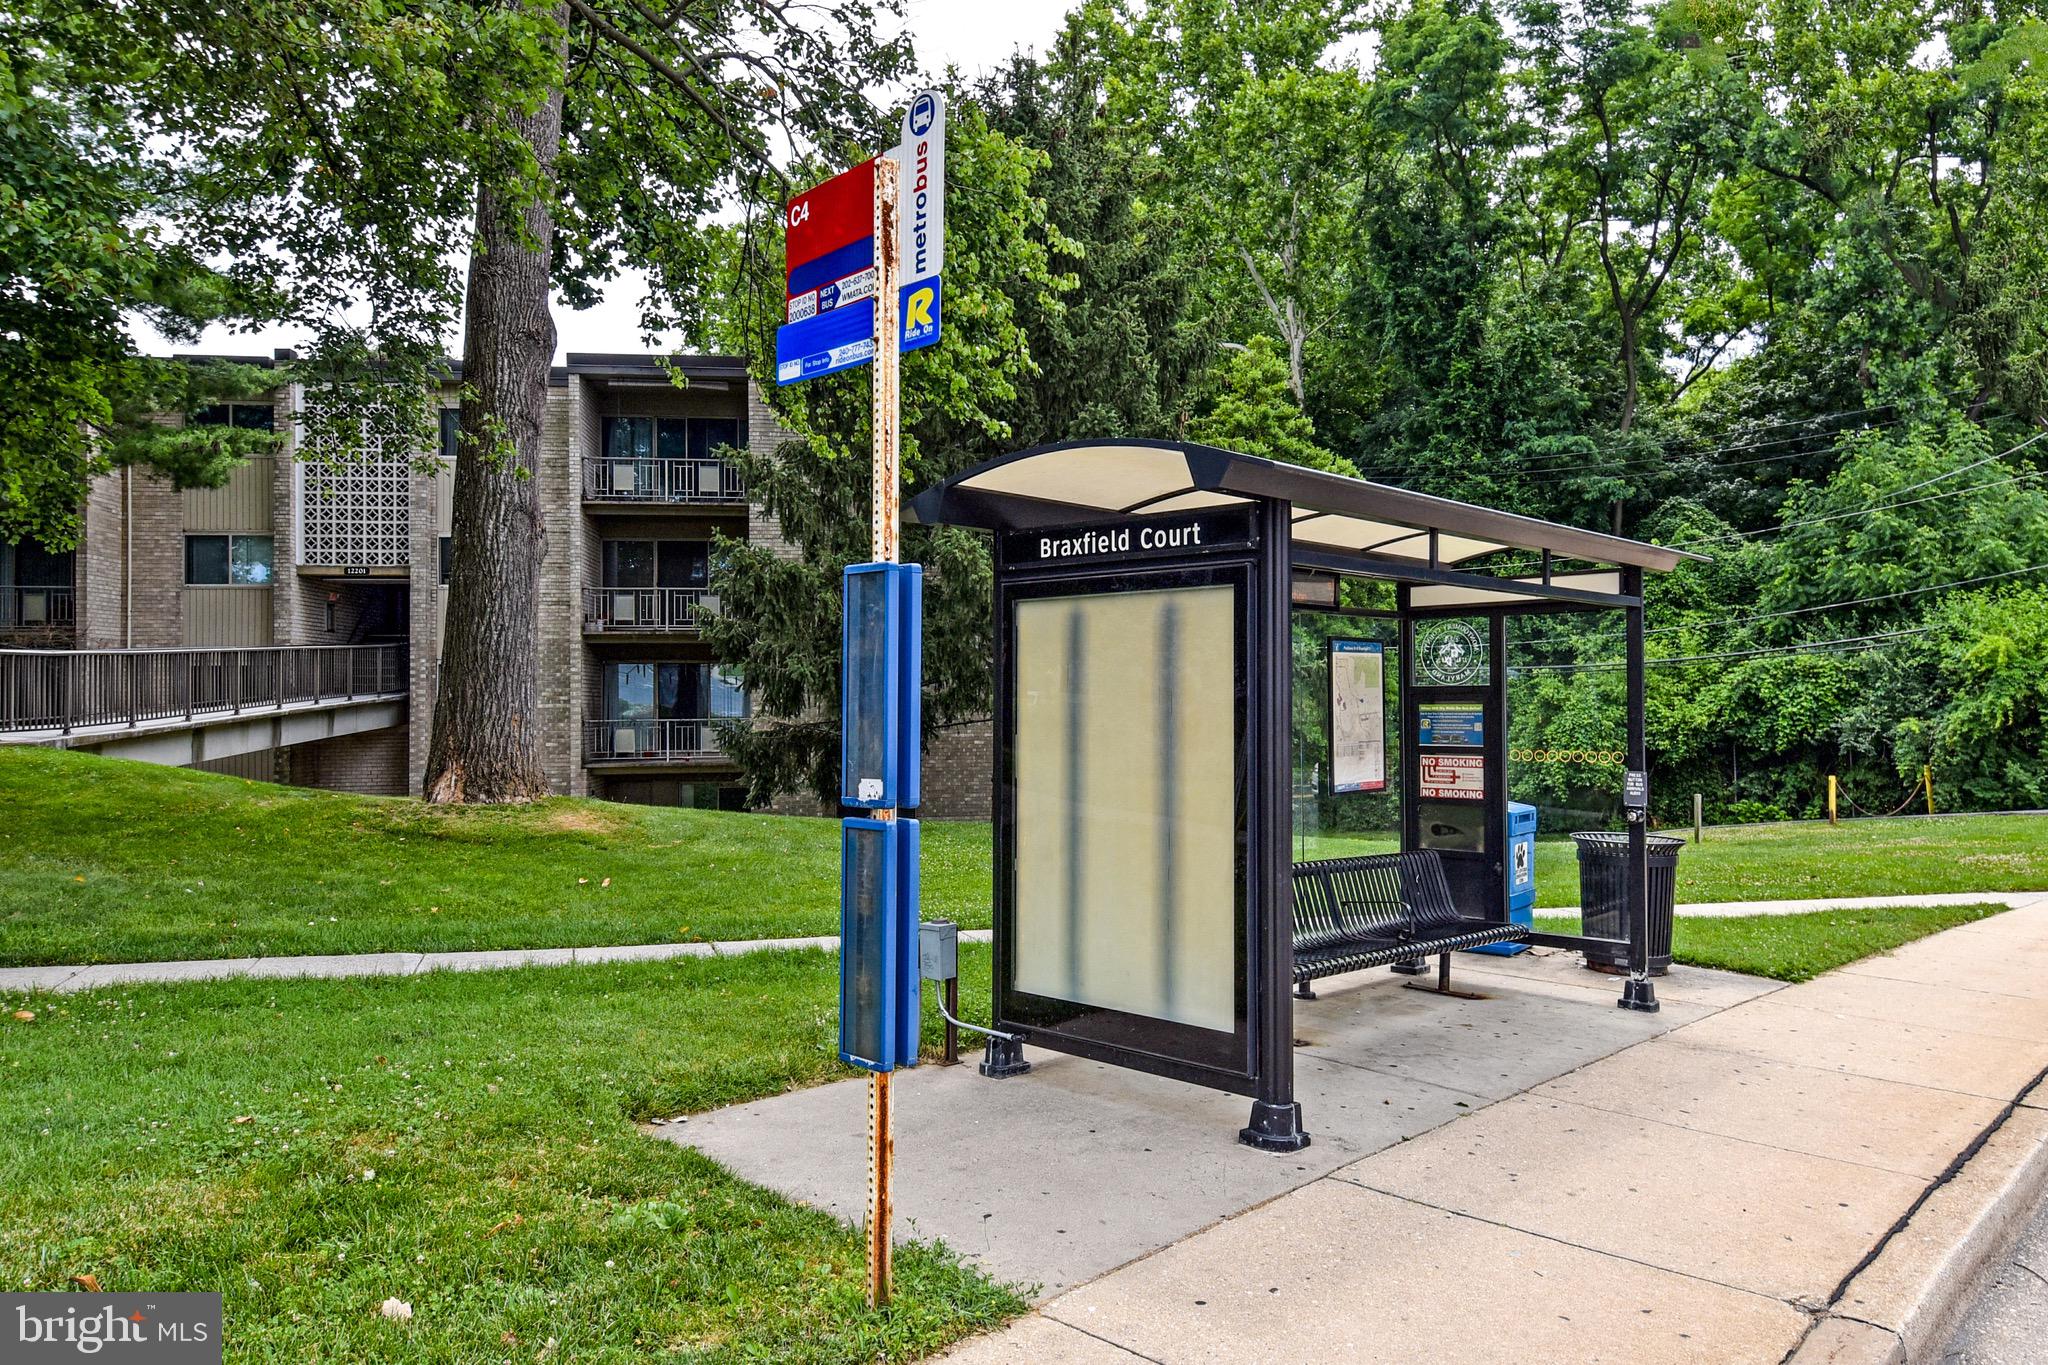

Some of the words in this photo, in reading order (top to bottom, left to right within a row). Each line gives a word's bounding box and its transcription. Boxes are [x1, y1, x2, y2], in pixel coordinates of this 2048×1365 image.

[790, 201, 810, 227] C4
[913, 141, 928, 273] metrobus
[841, 270, 875, 290] 202-637-700
[820, 285, 835, 298] NEXT
[789, 298, 801, 310] STOP
[821, 298, 834, 310] BUS
[906, 287, 934, 330] R
[789, 304, 815, 322] 2000638
[905, 328, 920, 339] Ride
[923, 325, 933, 334] On
[1040, 529, 1130, 559] Braxfield
[1140, 522, 1201, 549] Court
[1422, 758, 1436, 766] NO
[1438, 758, 1483, 767] SMOKING
[1422, 789, 1436, 797] NO
[1438, 789, 1484, 799] SMOKING
